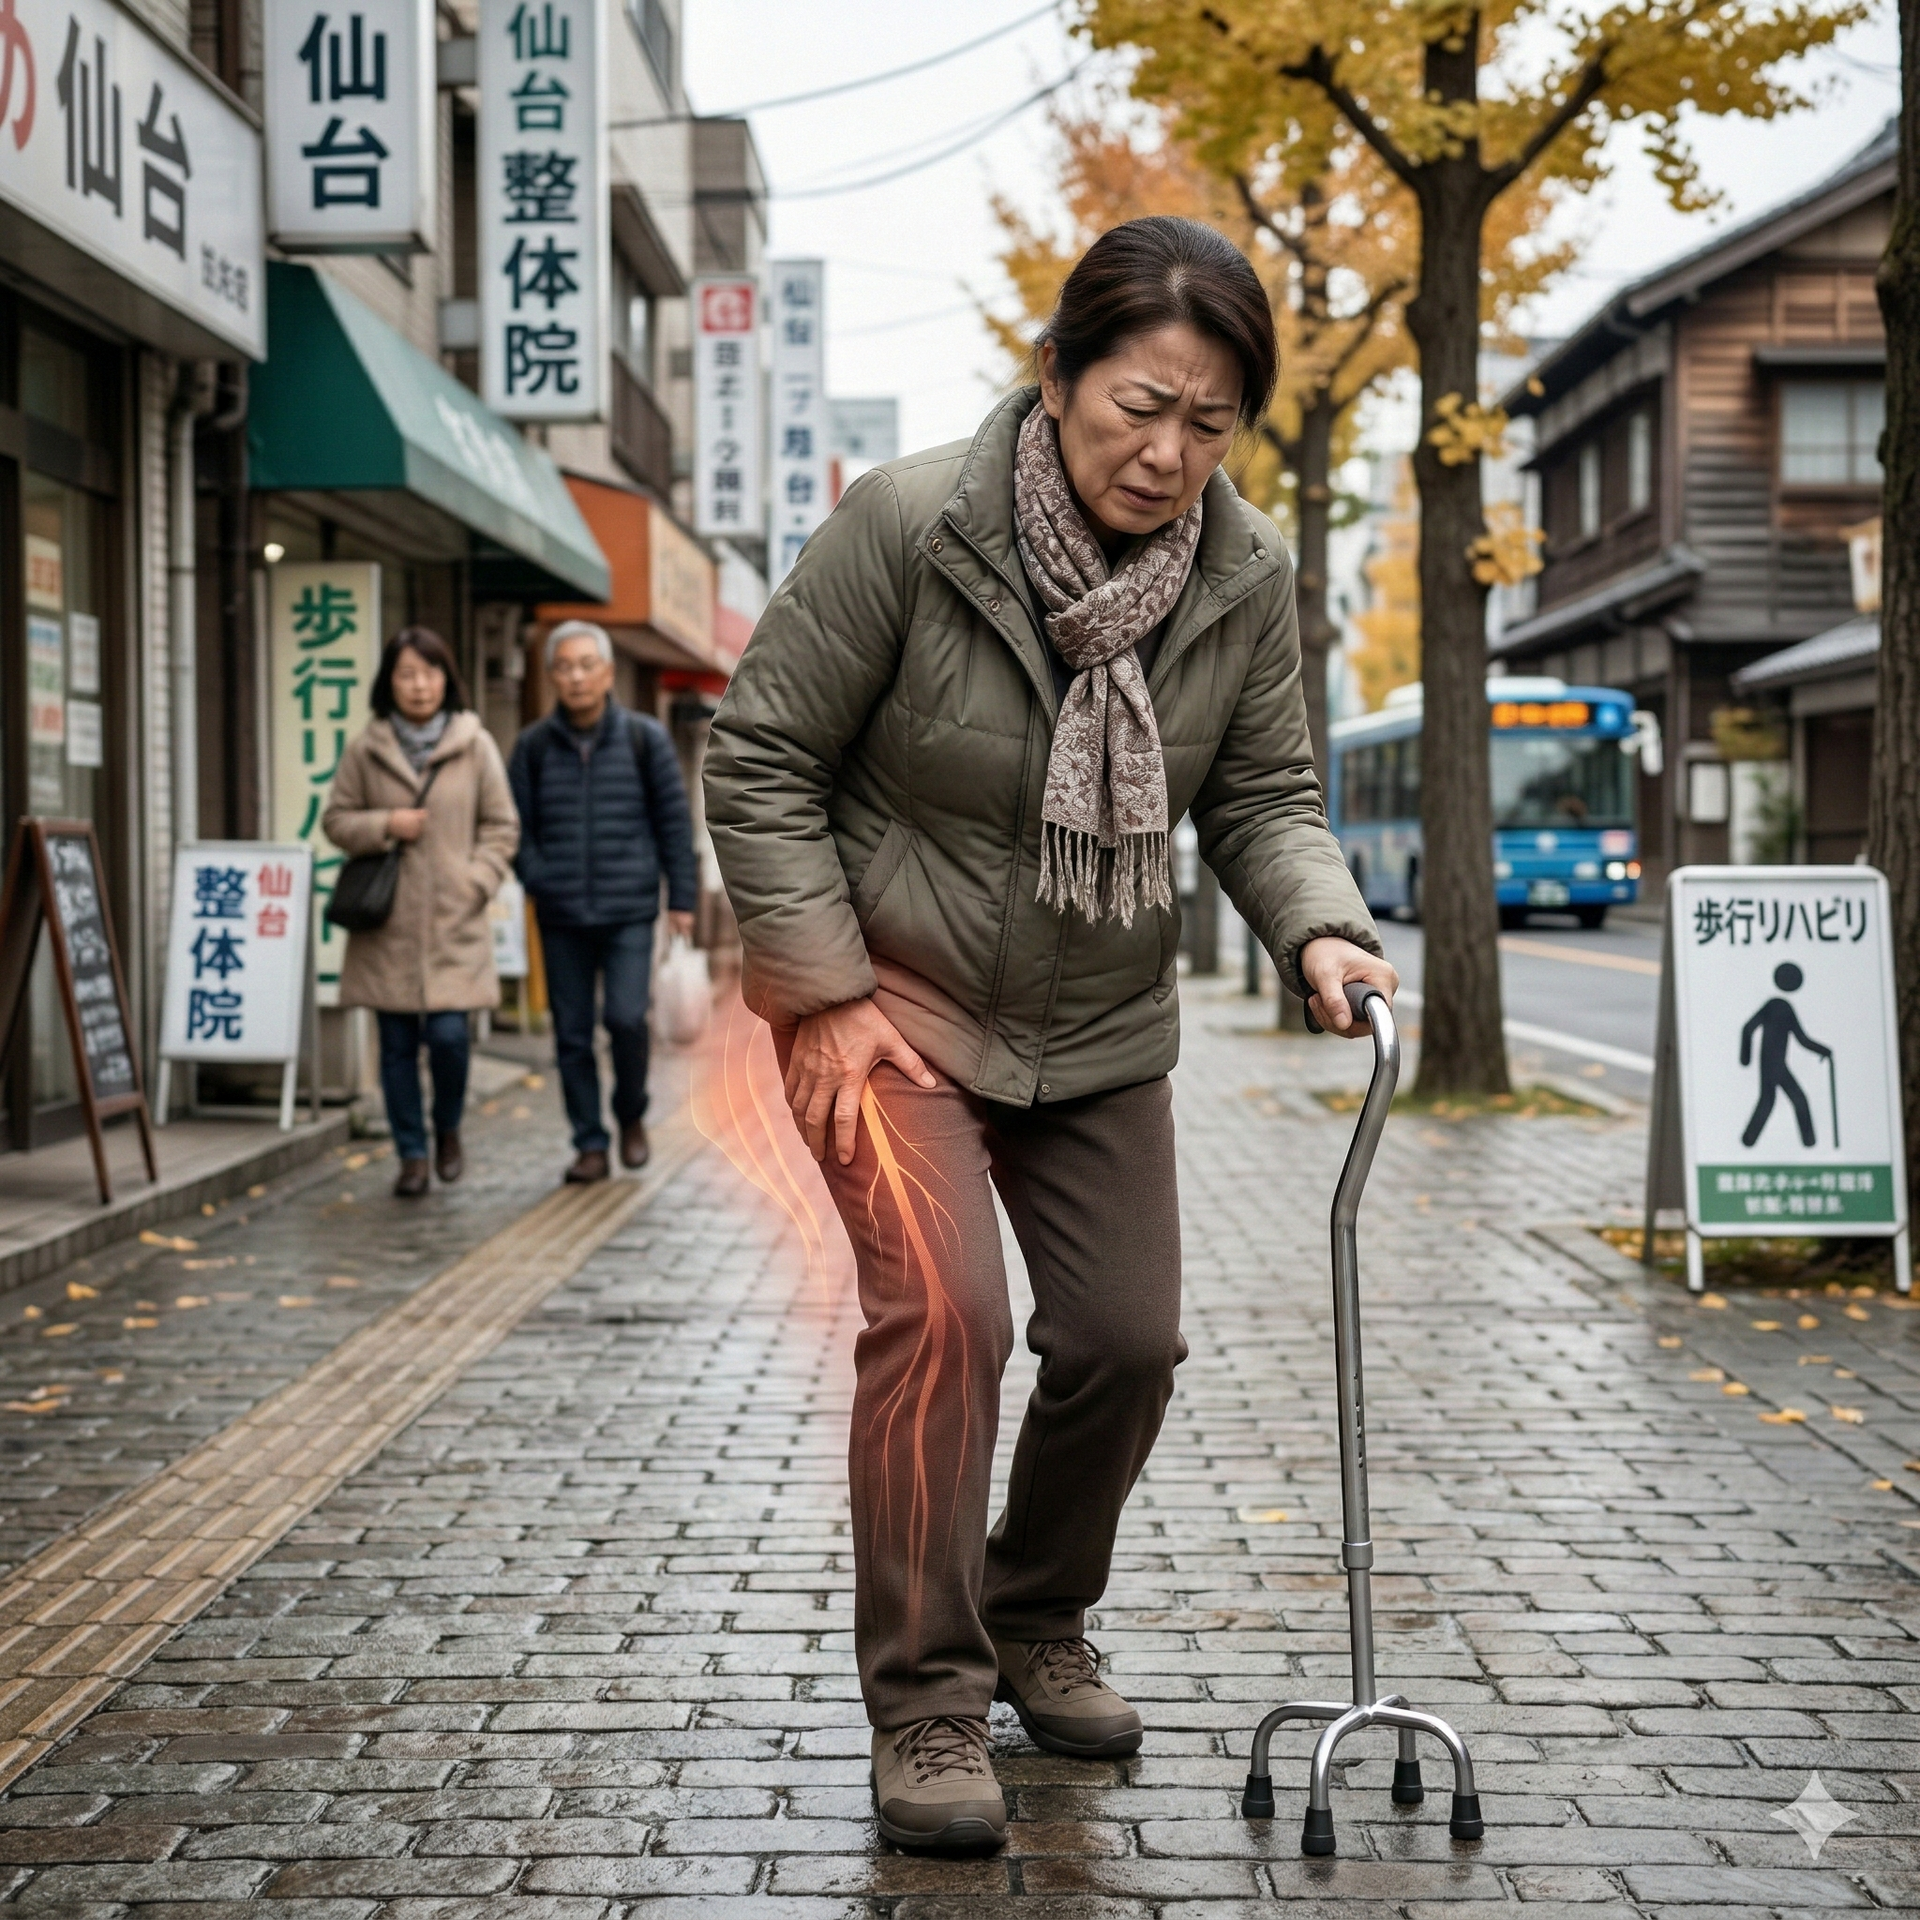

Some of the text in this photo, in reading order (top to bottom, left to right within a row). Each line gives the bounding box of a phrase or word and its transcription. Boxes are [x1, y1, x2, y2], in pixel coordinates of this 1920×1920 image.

[298, 13, 389, 210] 仙台
[502, 2, 580, 396] 仙台整体院
[187, 864, 248, 1041] 整体院
[257, 862, 293, 940] 仙台
[1694, 897, 1867, 946] 歩行リハビリ
